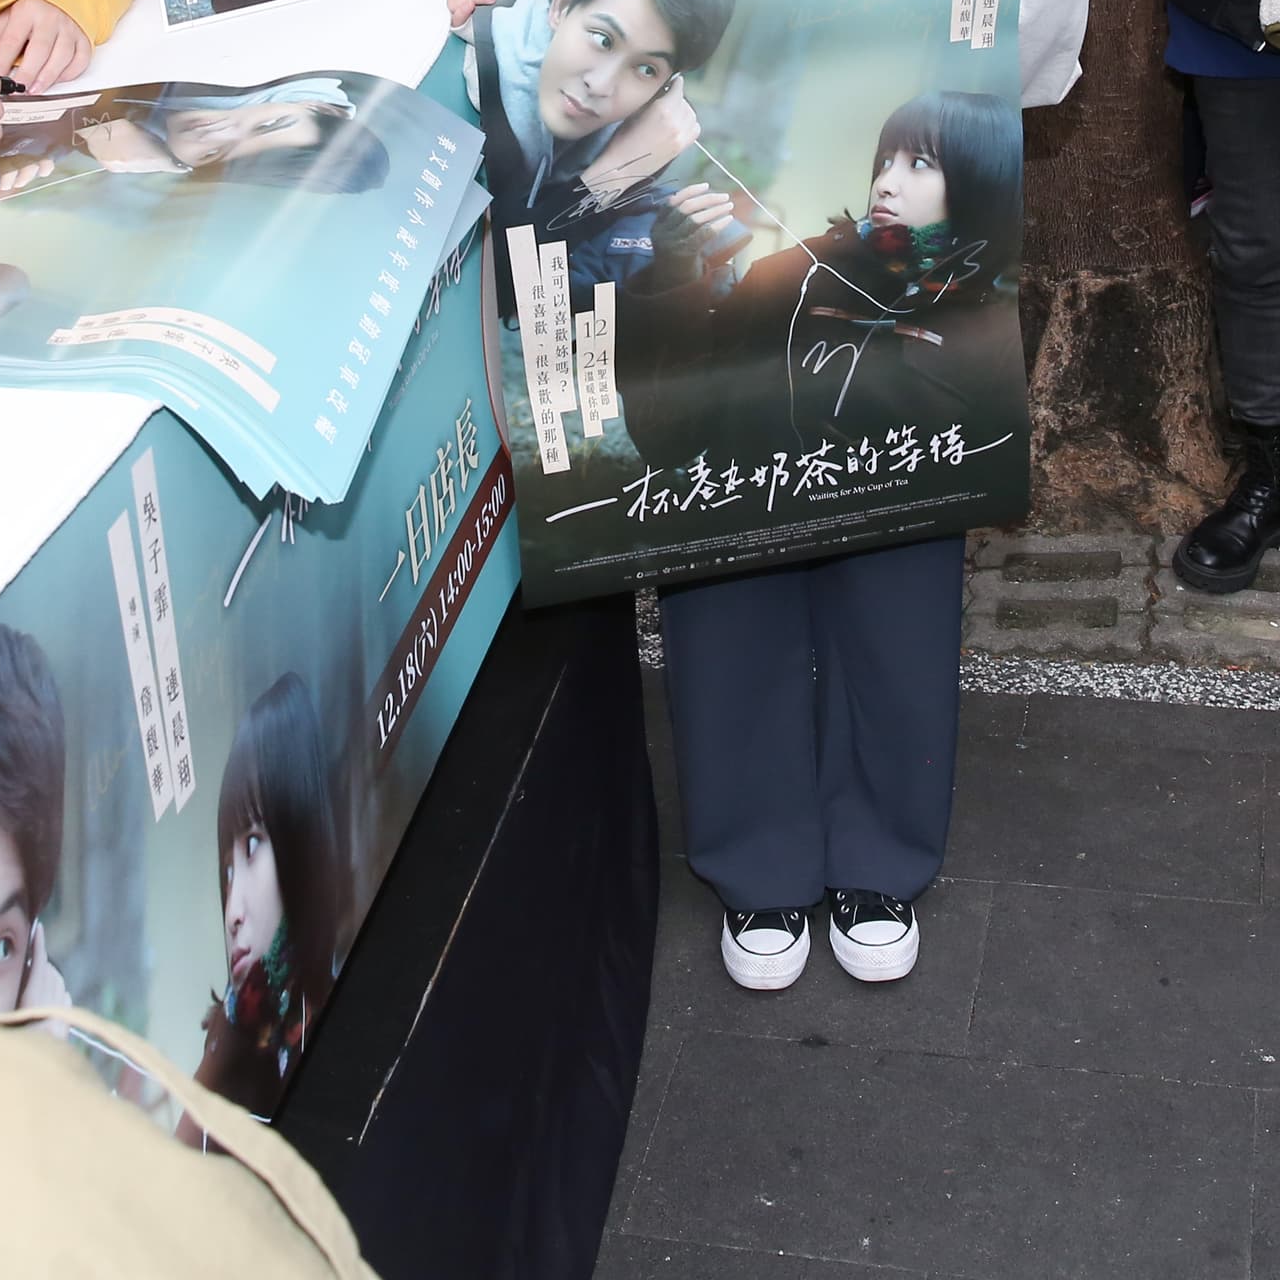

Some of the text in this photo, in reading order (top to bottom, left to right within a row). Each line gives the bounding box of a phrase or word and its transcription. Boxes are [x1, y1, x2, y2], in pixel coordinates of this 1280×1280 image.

[378, 396, 481, 603] 一日店長
[439, 471, 508, 617] 14:00-15:00
[545, 423, 1014, 523] 一杯熱奶茶的等待
[808, 477, 909, 502] Waiting for My Cup of Tea
[142, 491, 192, 796] 吳子霏 連晨翔
[373, 608, 440, 750] 12.18(六)
[139, 684, 164, 796] 詹馥華
